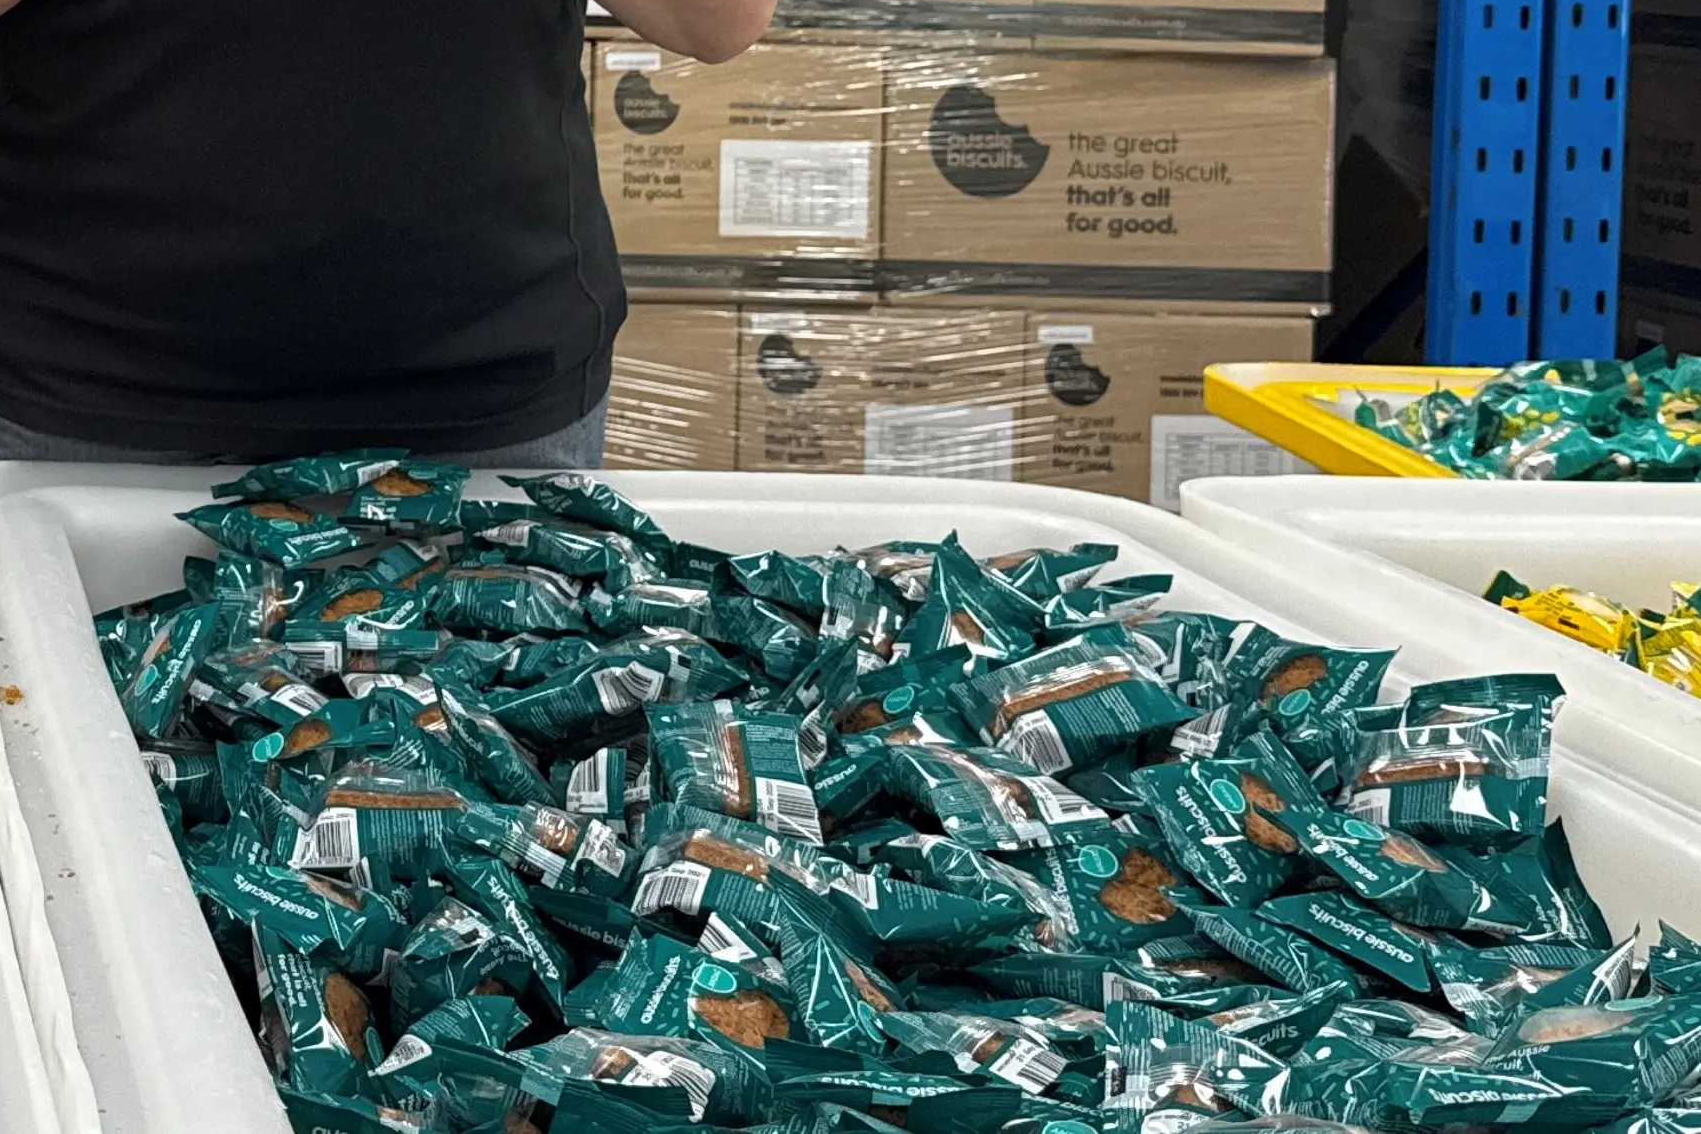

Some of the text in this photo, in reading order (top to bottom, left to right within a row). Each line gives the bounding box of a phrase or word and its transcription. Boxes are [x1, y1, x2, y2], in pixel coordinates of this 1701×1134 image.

[623, 142, 684, 156] the great
[1068, 132, 1179, 158] the great
[623, 172, 660, 184] that's
[1068, 159, 1232, 185] Aussie biscuit,
[623, 187, 641, 199] for
[1066, 185, 1171, 207] that's all
[1066, 213, 1178, 238] for good.
[1341, 660, 1369, 696] aussie
[1176, 786, 1217, 837] biscuits
[233, 873, 319, 919] biscuits aussie
[1309, 903, 1414, 963] biscuits aussie
[526, 930, 560, 981] aussie
